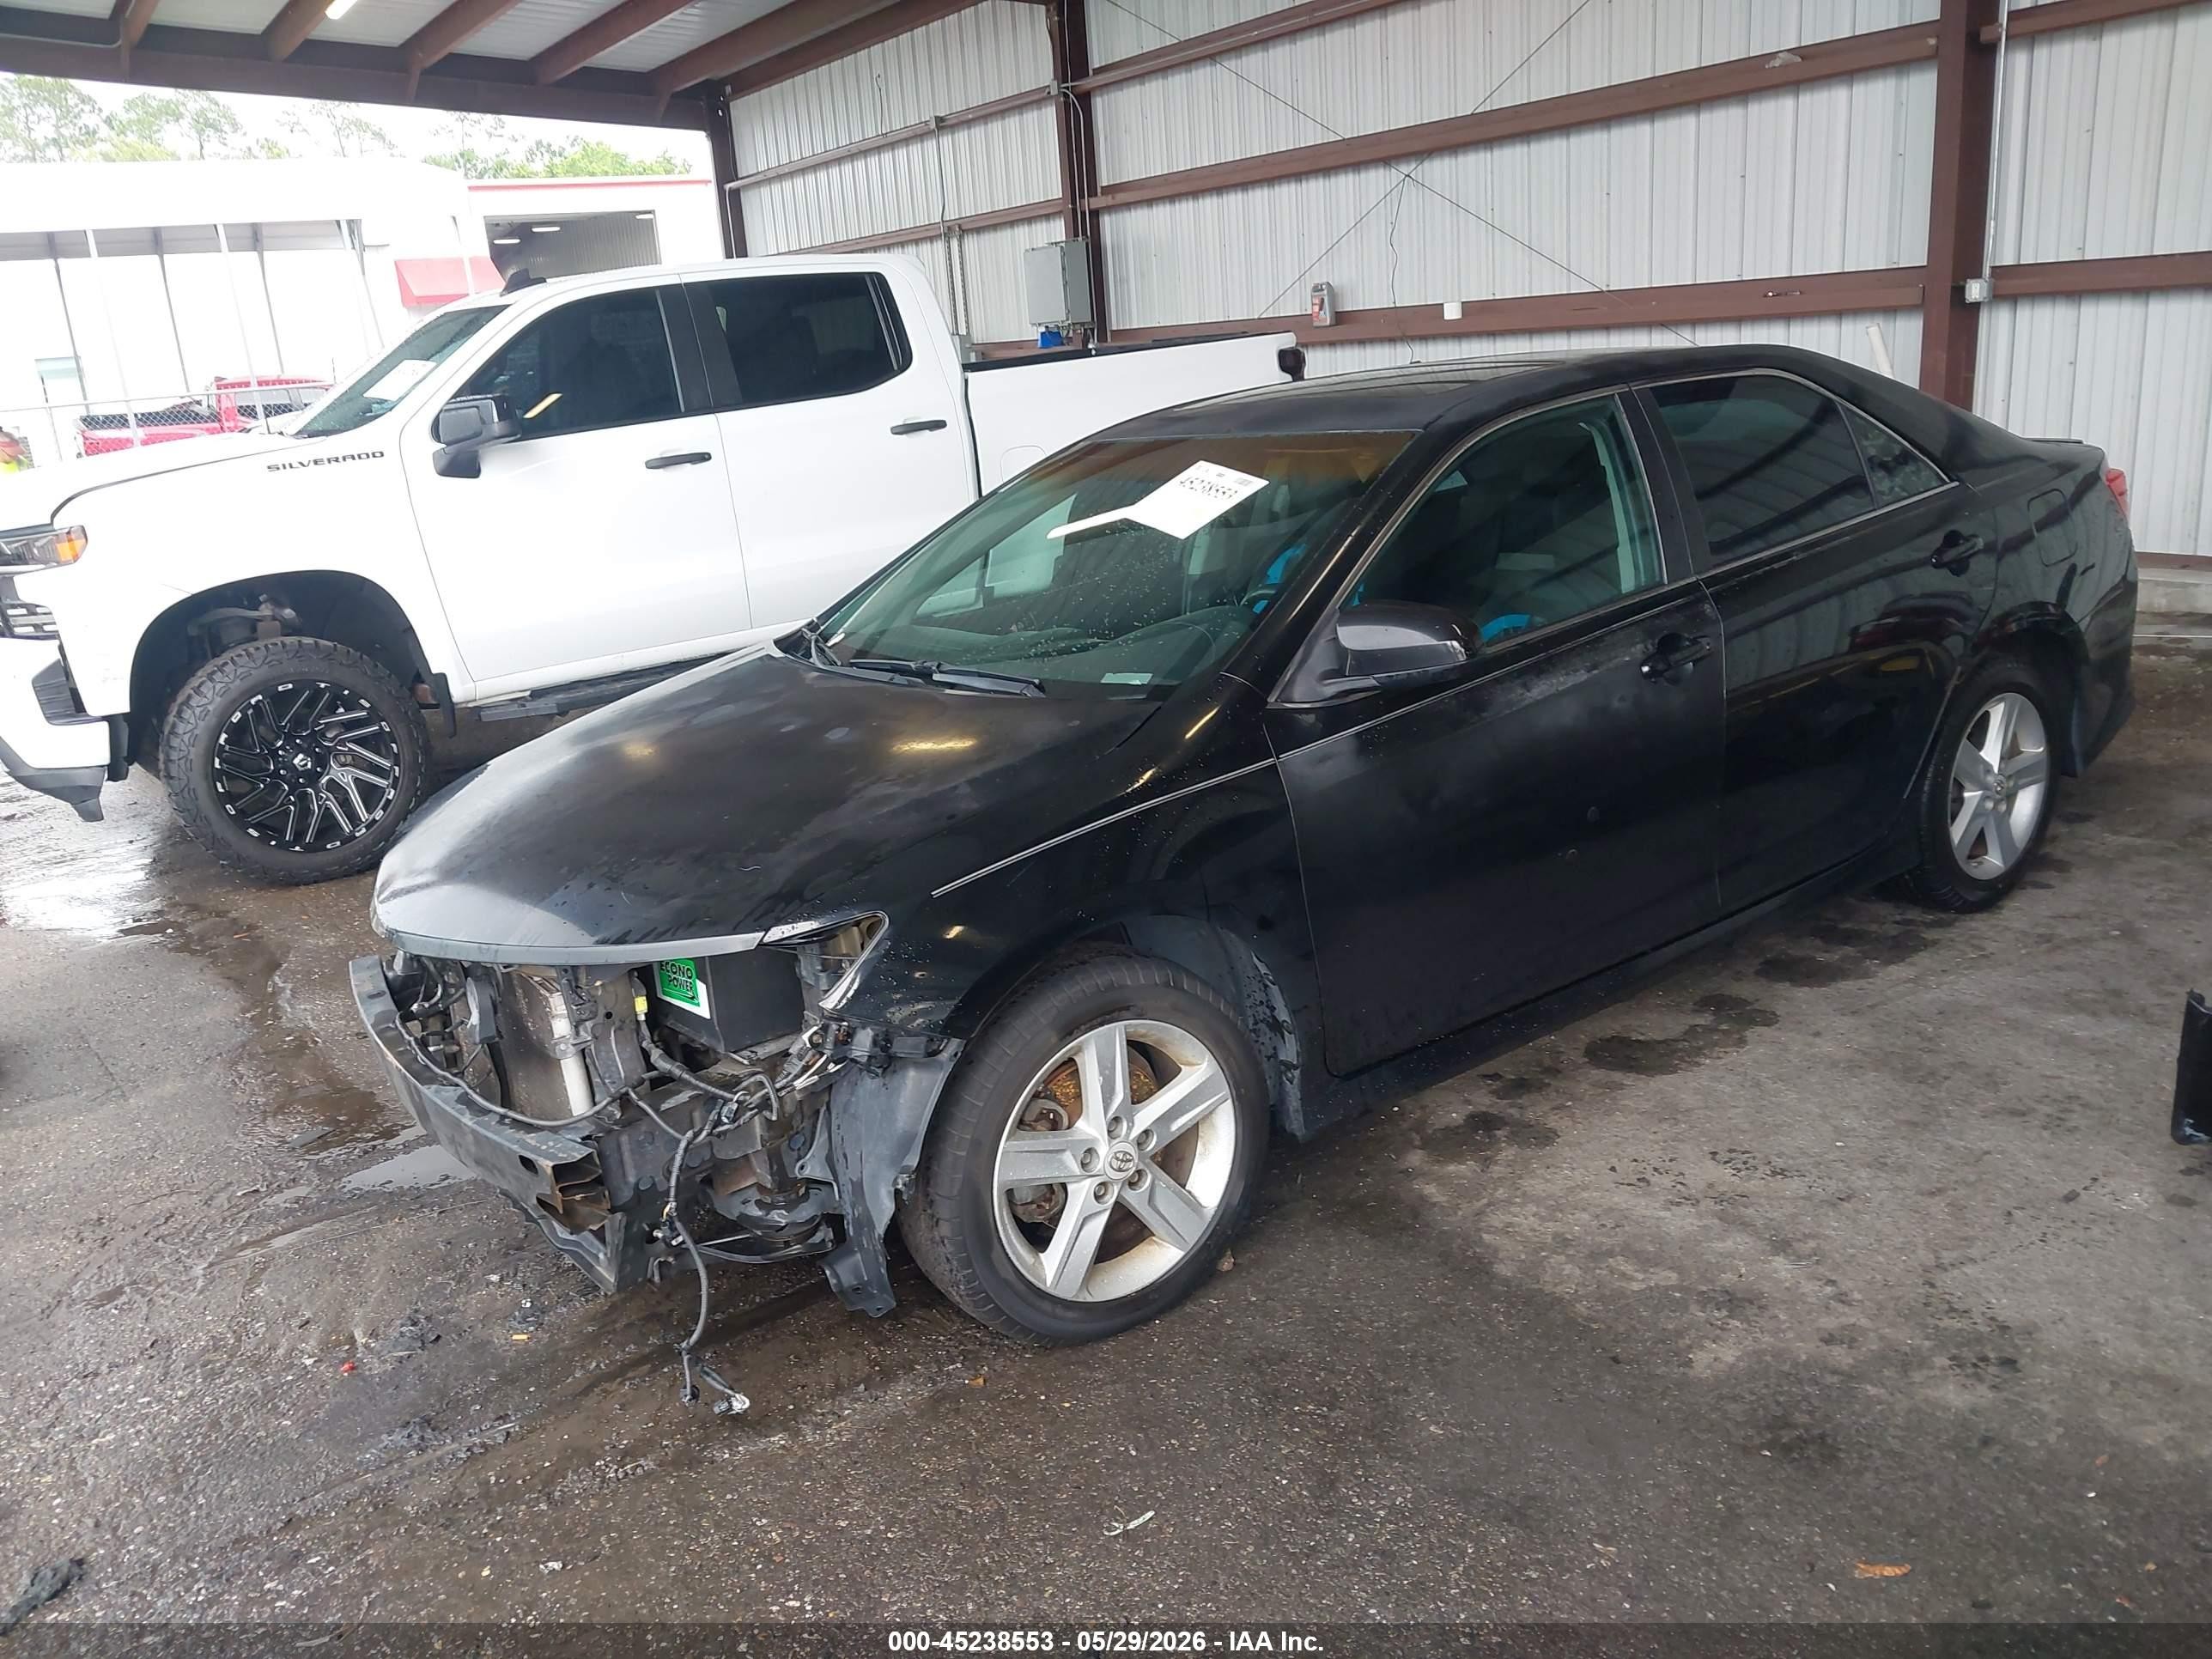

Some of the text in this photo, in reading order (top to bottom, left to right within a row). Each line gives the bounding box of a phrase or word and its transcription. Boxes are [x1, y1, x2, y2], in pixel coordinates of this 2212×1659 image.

[266, 451, 385, 472] SILVERADO
[659, 961, 693, 981] ECONO
[667, 974, 694, 994] POWER
